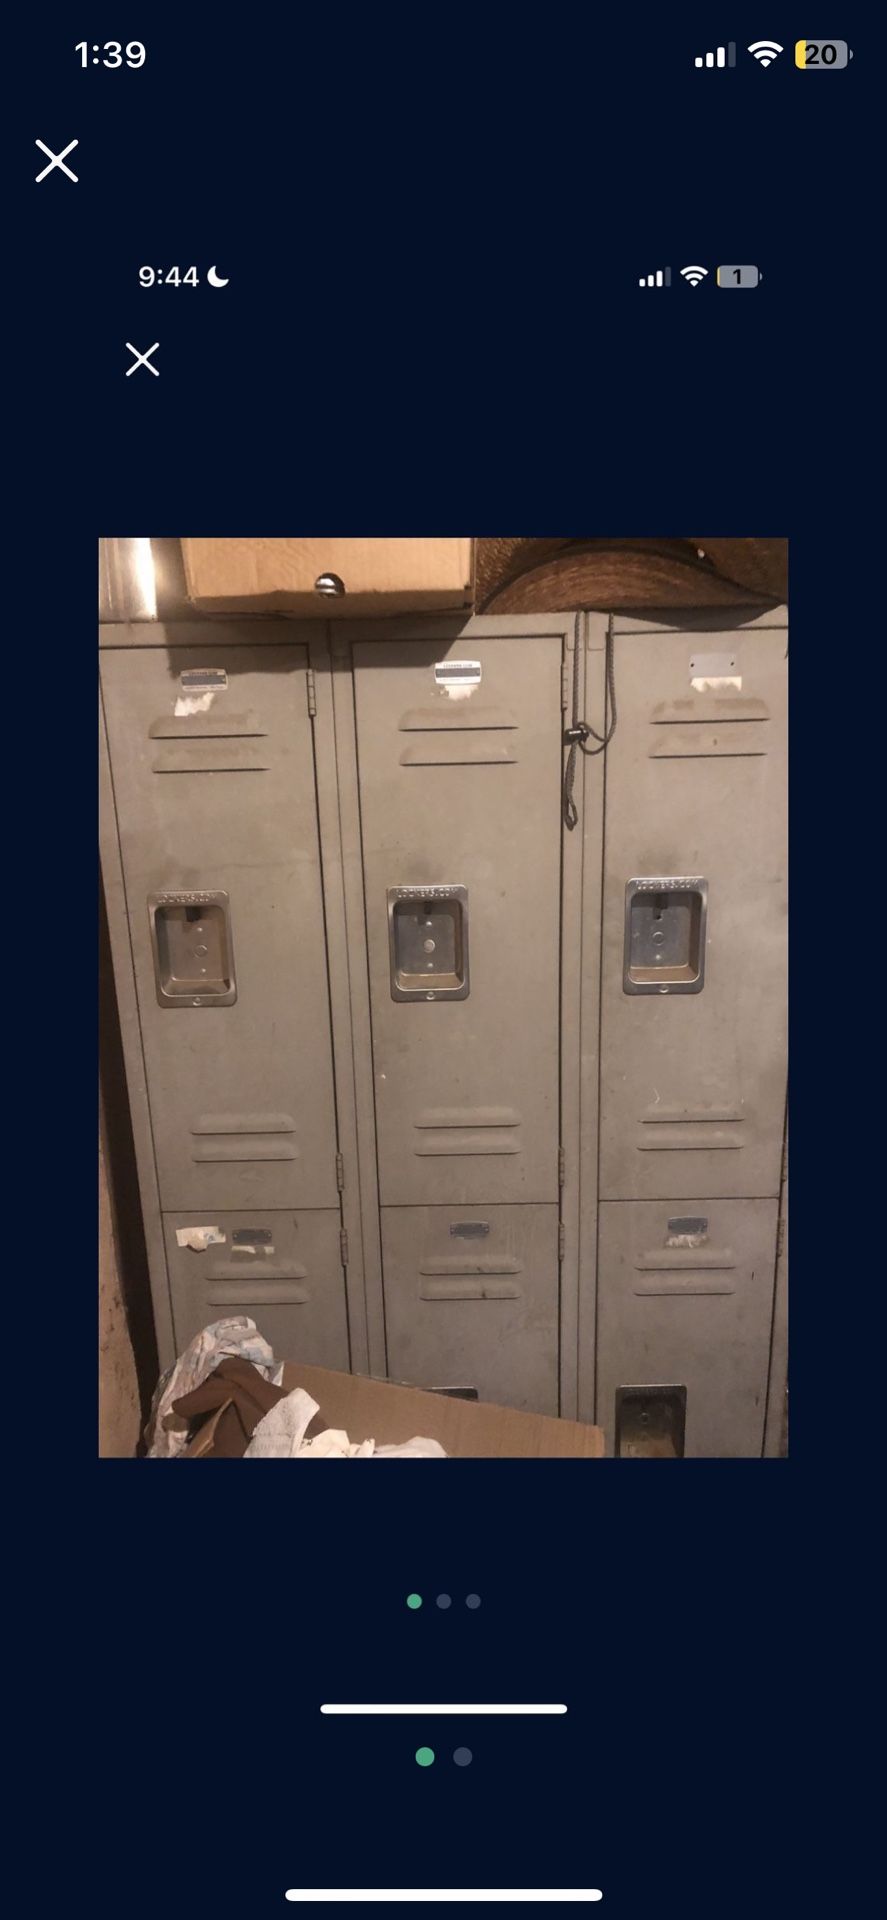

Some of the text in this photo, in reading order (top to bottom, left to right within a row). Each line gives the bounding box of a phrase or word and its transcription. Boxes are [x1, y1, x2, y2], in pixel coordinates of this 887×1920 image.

[75, 41, 146, 68] 1:39
[805, 44, 837, 64] 20
[139, 266, 200, 287] 9:44
[733, 269, 741, 284] 1
